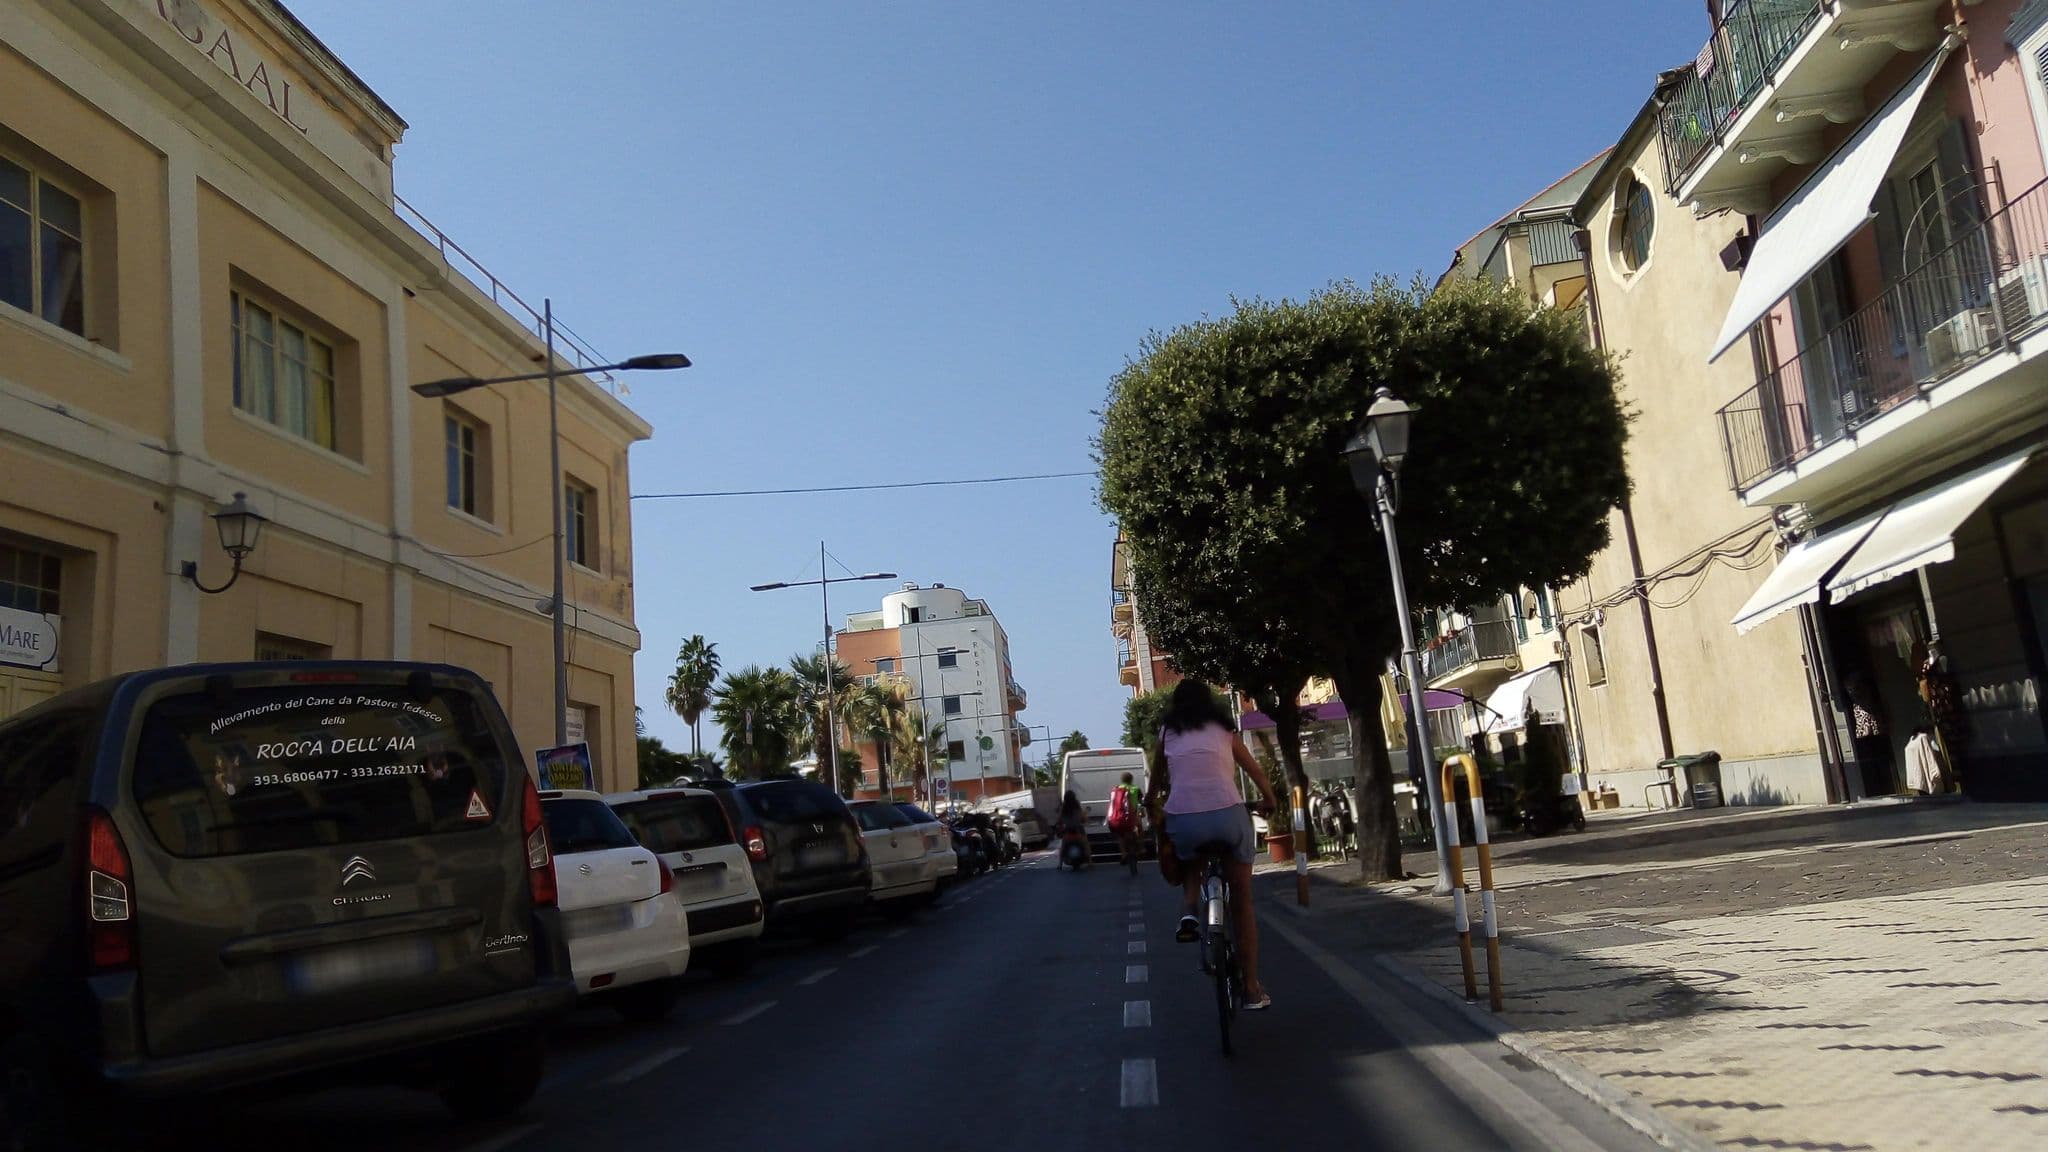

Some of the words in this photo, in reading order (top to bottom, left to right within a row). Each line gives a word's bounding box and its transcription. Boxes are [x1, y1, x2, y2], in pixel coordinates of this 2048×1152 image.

[0, 623, 40, 650] MARE
[210, 702, 282, 735] Allevamento
[285, 698, 303, 709] del
[306, 696, 335, 706] Cane
[338, 696, 352, 705] da
[356, 696, 398, 709] Pastore
[402, 702, 442, 722] Tedesco
[321, 716, 346, 725] della
[256, 740, 323, 760] ROCCA
[385, 736, 416, 751] AIA
[254, 769, 339, 786] 393.6806477
[351, 764, 427, 778] 333.2622171
